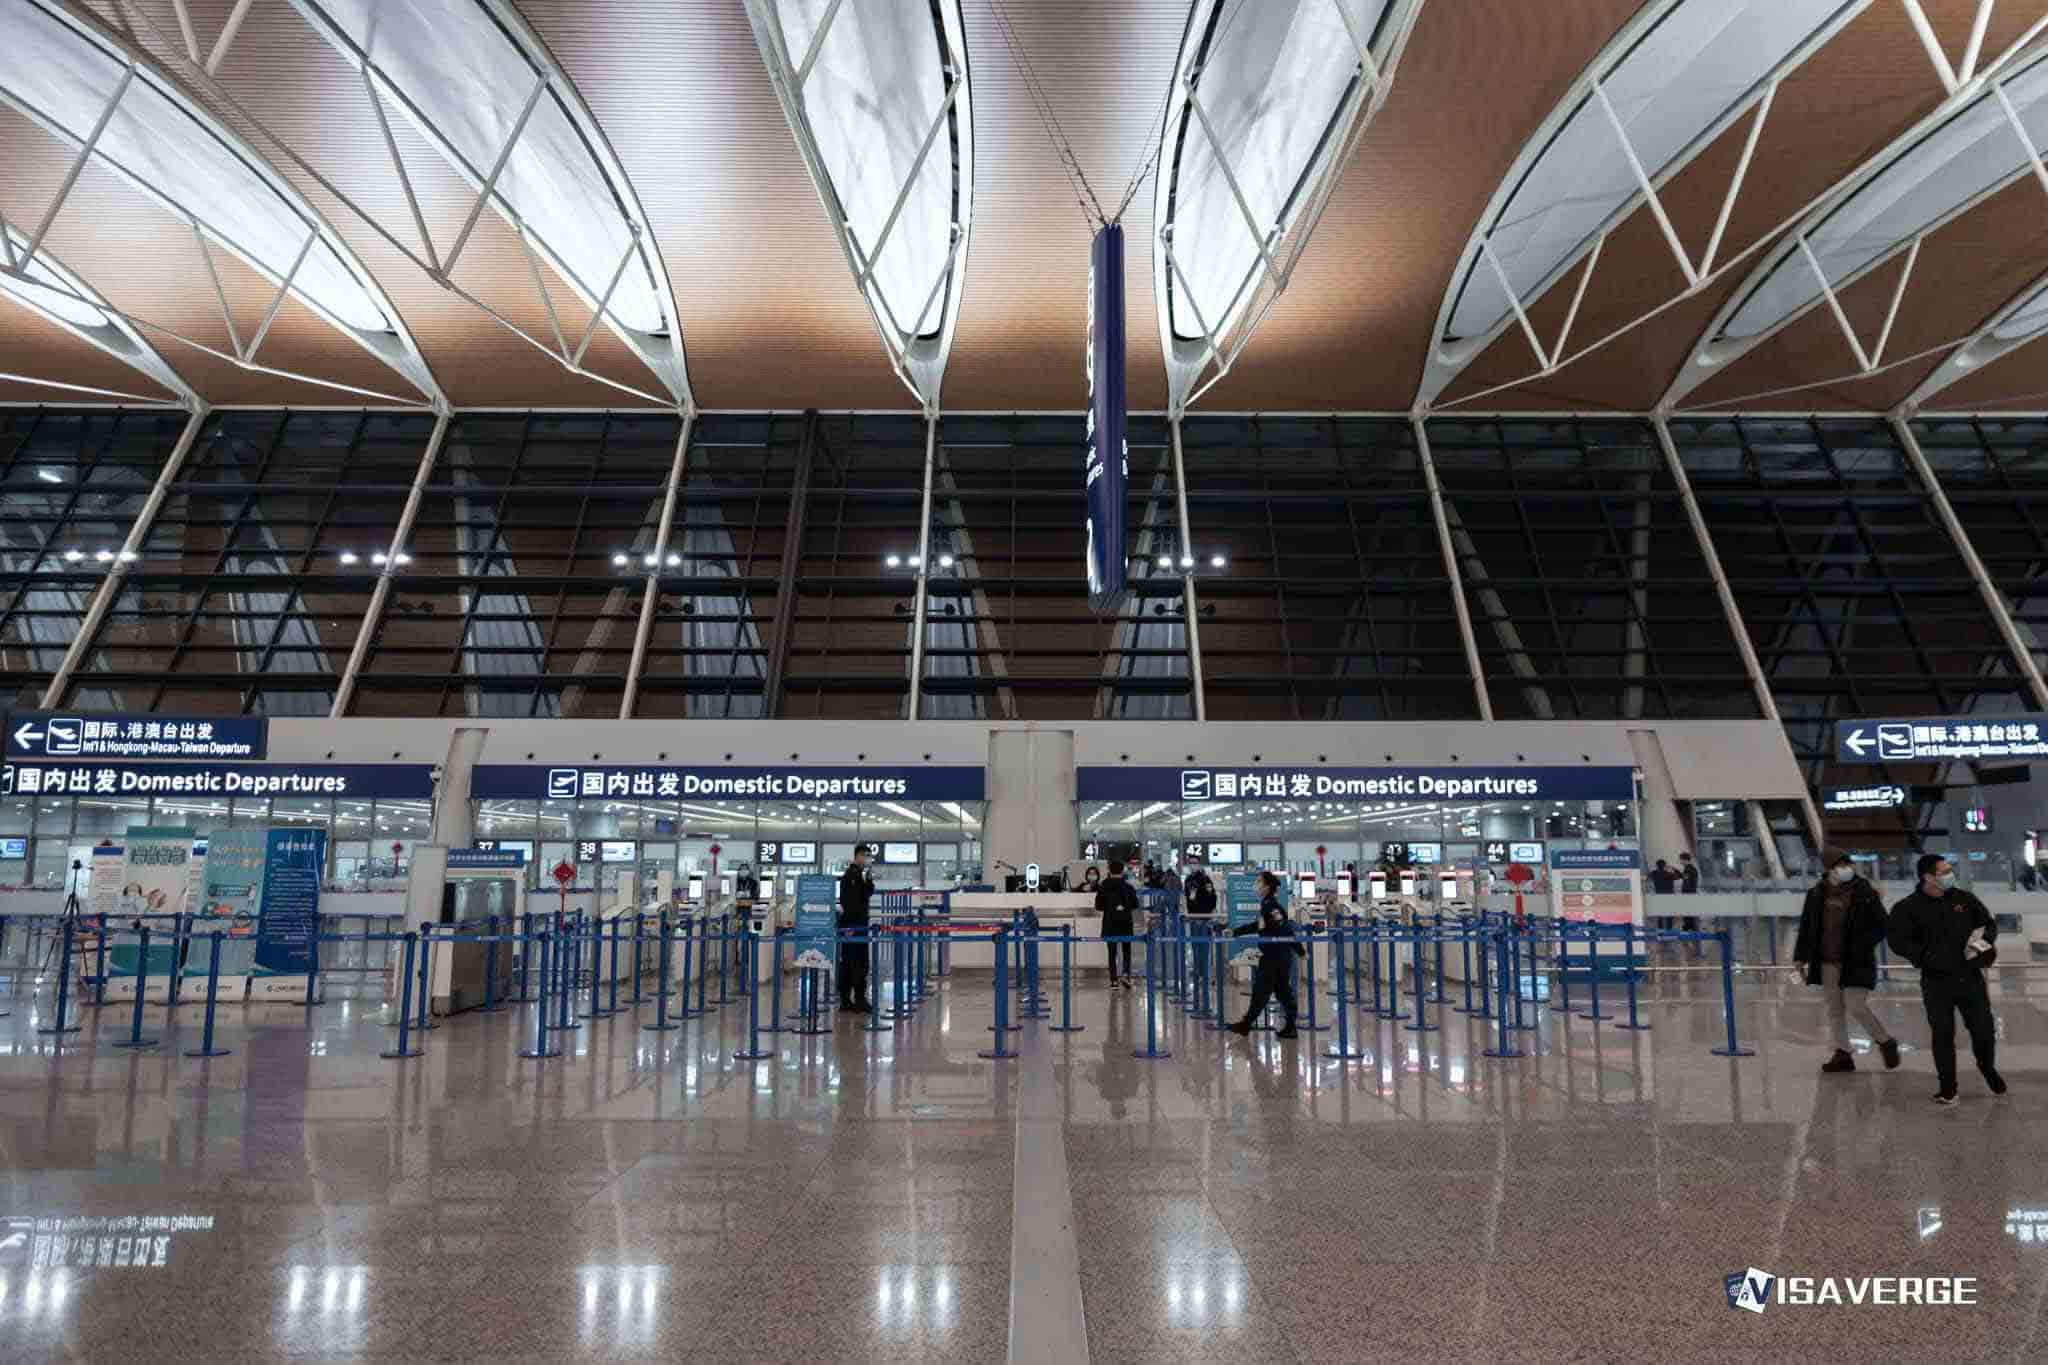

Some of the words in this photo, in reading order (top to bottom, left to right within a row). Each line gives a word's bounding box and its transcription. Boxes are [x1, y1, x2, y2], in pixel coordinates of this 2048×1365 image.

[84, 721, 213, 740] 国际、港澳台出发
[99, 742, 106, 753] &
[210, 743, 250, 755] Departure
[18, 768, 117, 792] 国内出发
[121, 771, 221, 791] Domestic
[225, 772, 345, 795] Departures
[583, 772, 679, 795] 国内出发
[684, 775, 782, 794] Domestic
[787, 776, 906, 797] Departures
[1215, 773, 1312, 796] 国内出发
[1317, 775, 1415, 795] Domestic
[1419, 776, 1537, 798] Departures
[580, 842, 595, 854] 38
[761, 843, 776, 855] 39
[866, 843, 879, 856] 0
[1186, 843, 1202, 855] 42
[1488, 843, 1504, 855] 44
